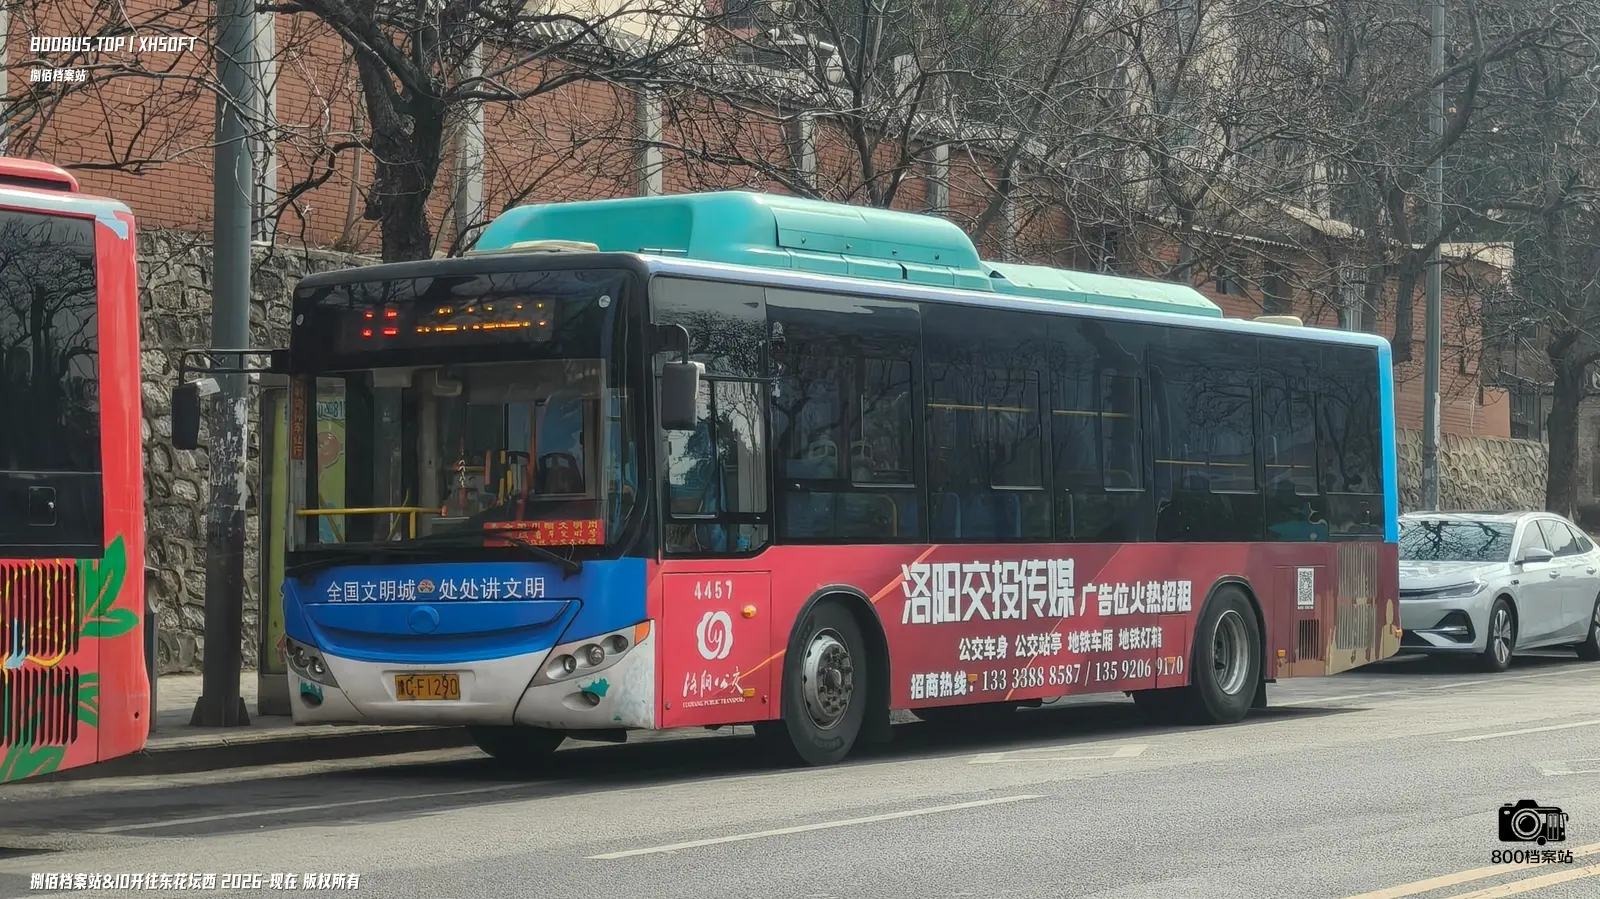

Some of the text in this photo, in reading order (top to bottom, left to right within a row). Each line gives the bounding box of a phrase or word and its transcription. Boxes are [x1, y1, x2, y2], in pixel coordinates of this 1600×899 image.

[326, 577, 545, 603] 全国文明城 处处讲文明
[694, 580, 733, 600] 4457
[900, 557, 1192, 625] 洛阳交投传媒 广告位火热招租
[959, 626, 1163, 661] 公交车身 公交站亭 地铁车厢 地铁灯箱
[682, 665, 744, 698] 洛阳公交
[982, 669, 1007, 691] 133
[1011, 666, 1044, 689] 3388
[1049, 663, 1081, 686] 8587
[1095, 661, 1118, 682] 135
[1121, 658, 1151, 679] 9206
[1156, 655, 1184, 677] 9170
